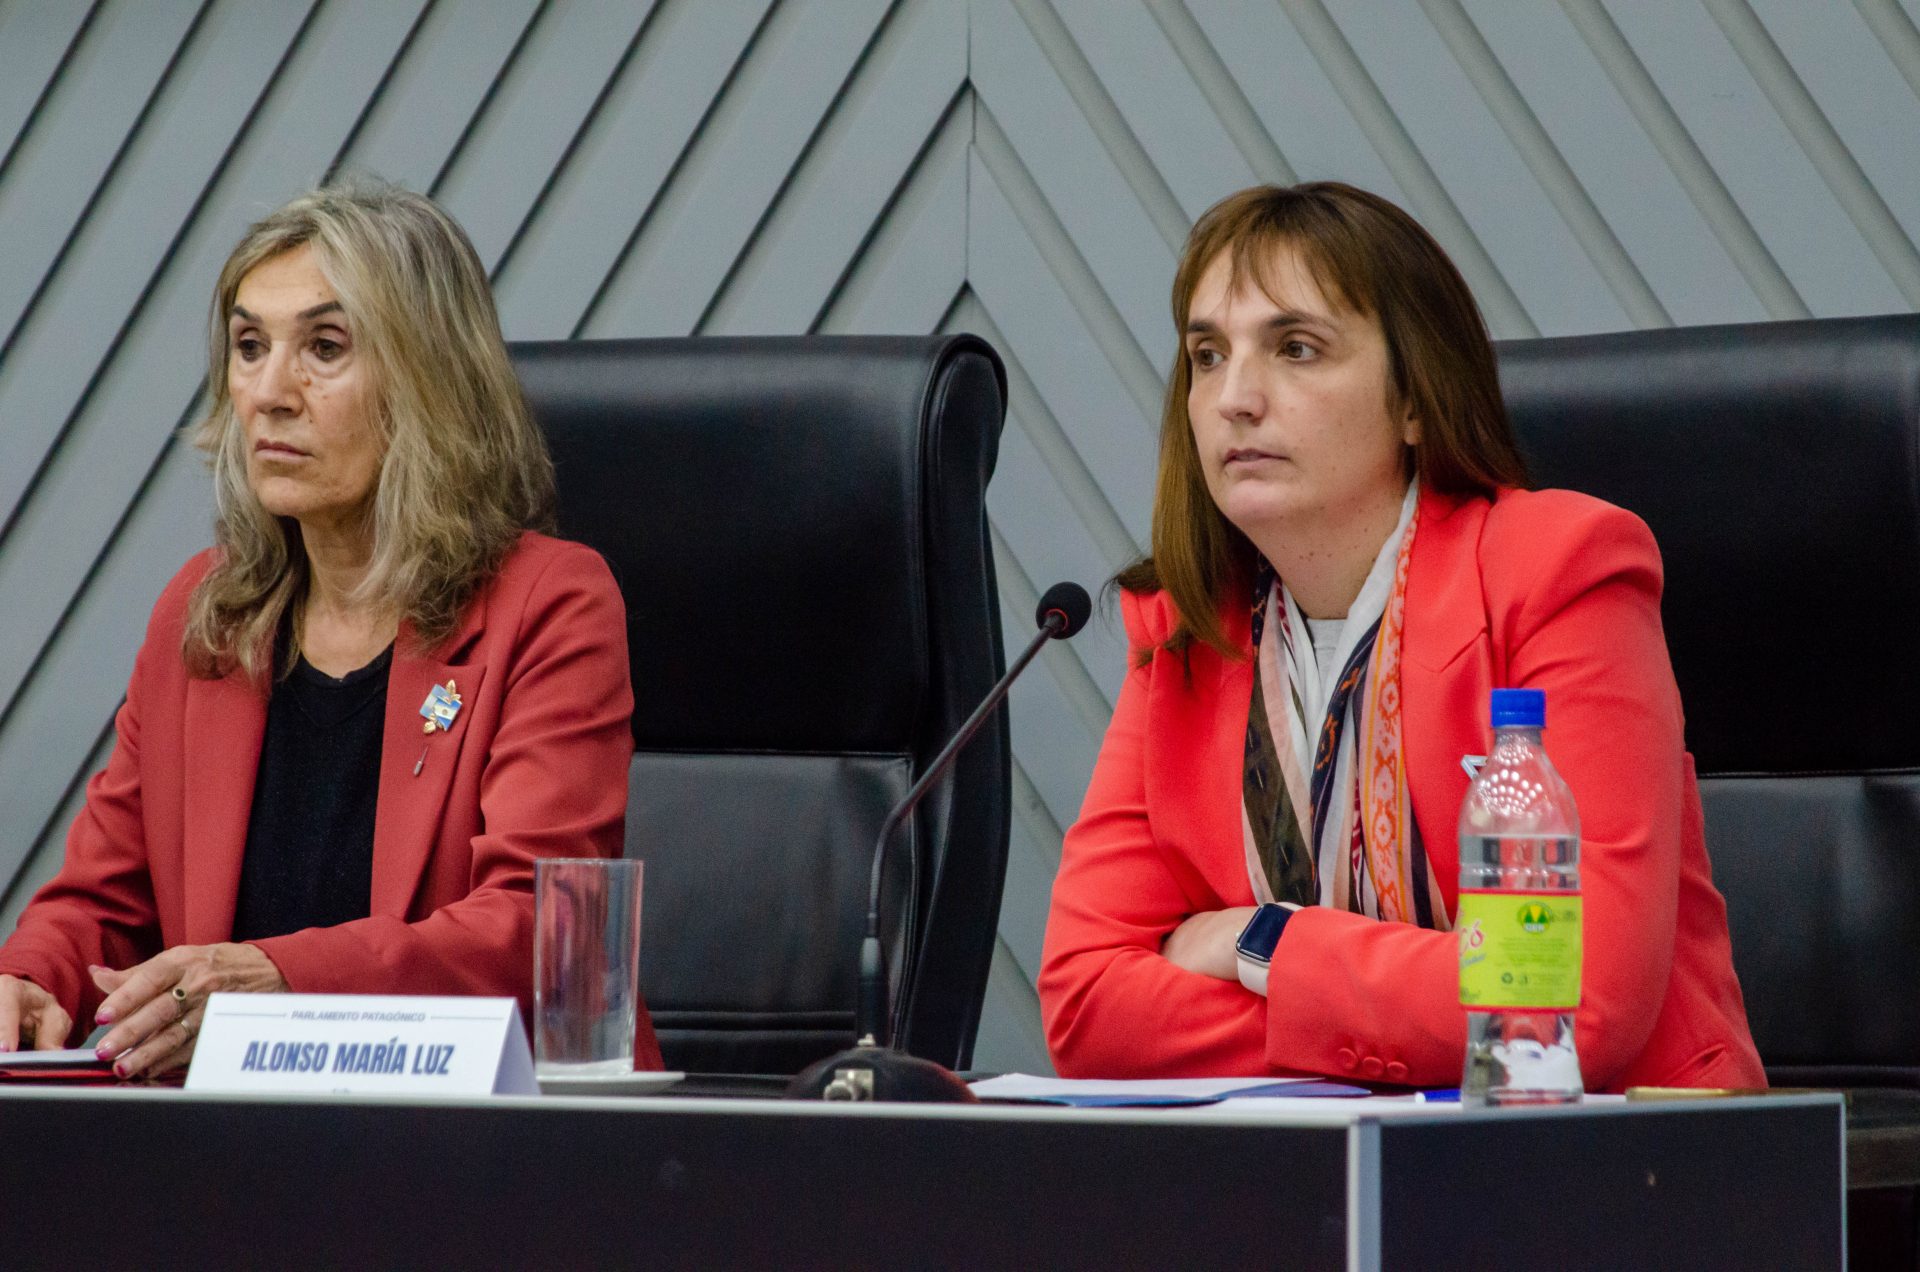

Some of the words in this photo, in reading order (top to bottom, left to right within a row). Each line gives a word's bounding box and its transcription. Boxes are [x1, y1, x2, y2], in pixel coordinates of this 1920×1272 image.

[291, 1010, 360, 1021] PARLAMENTO
[361, 1010, 426, 1022] PATAGÓNICO
[240, 1040, 330, 1073] ALONSO
[332, 1036, 408, 1075] MARÍA
[410, 1044, 455, 1076] LUZ
